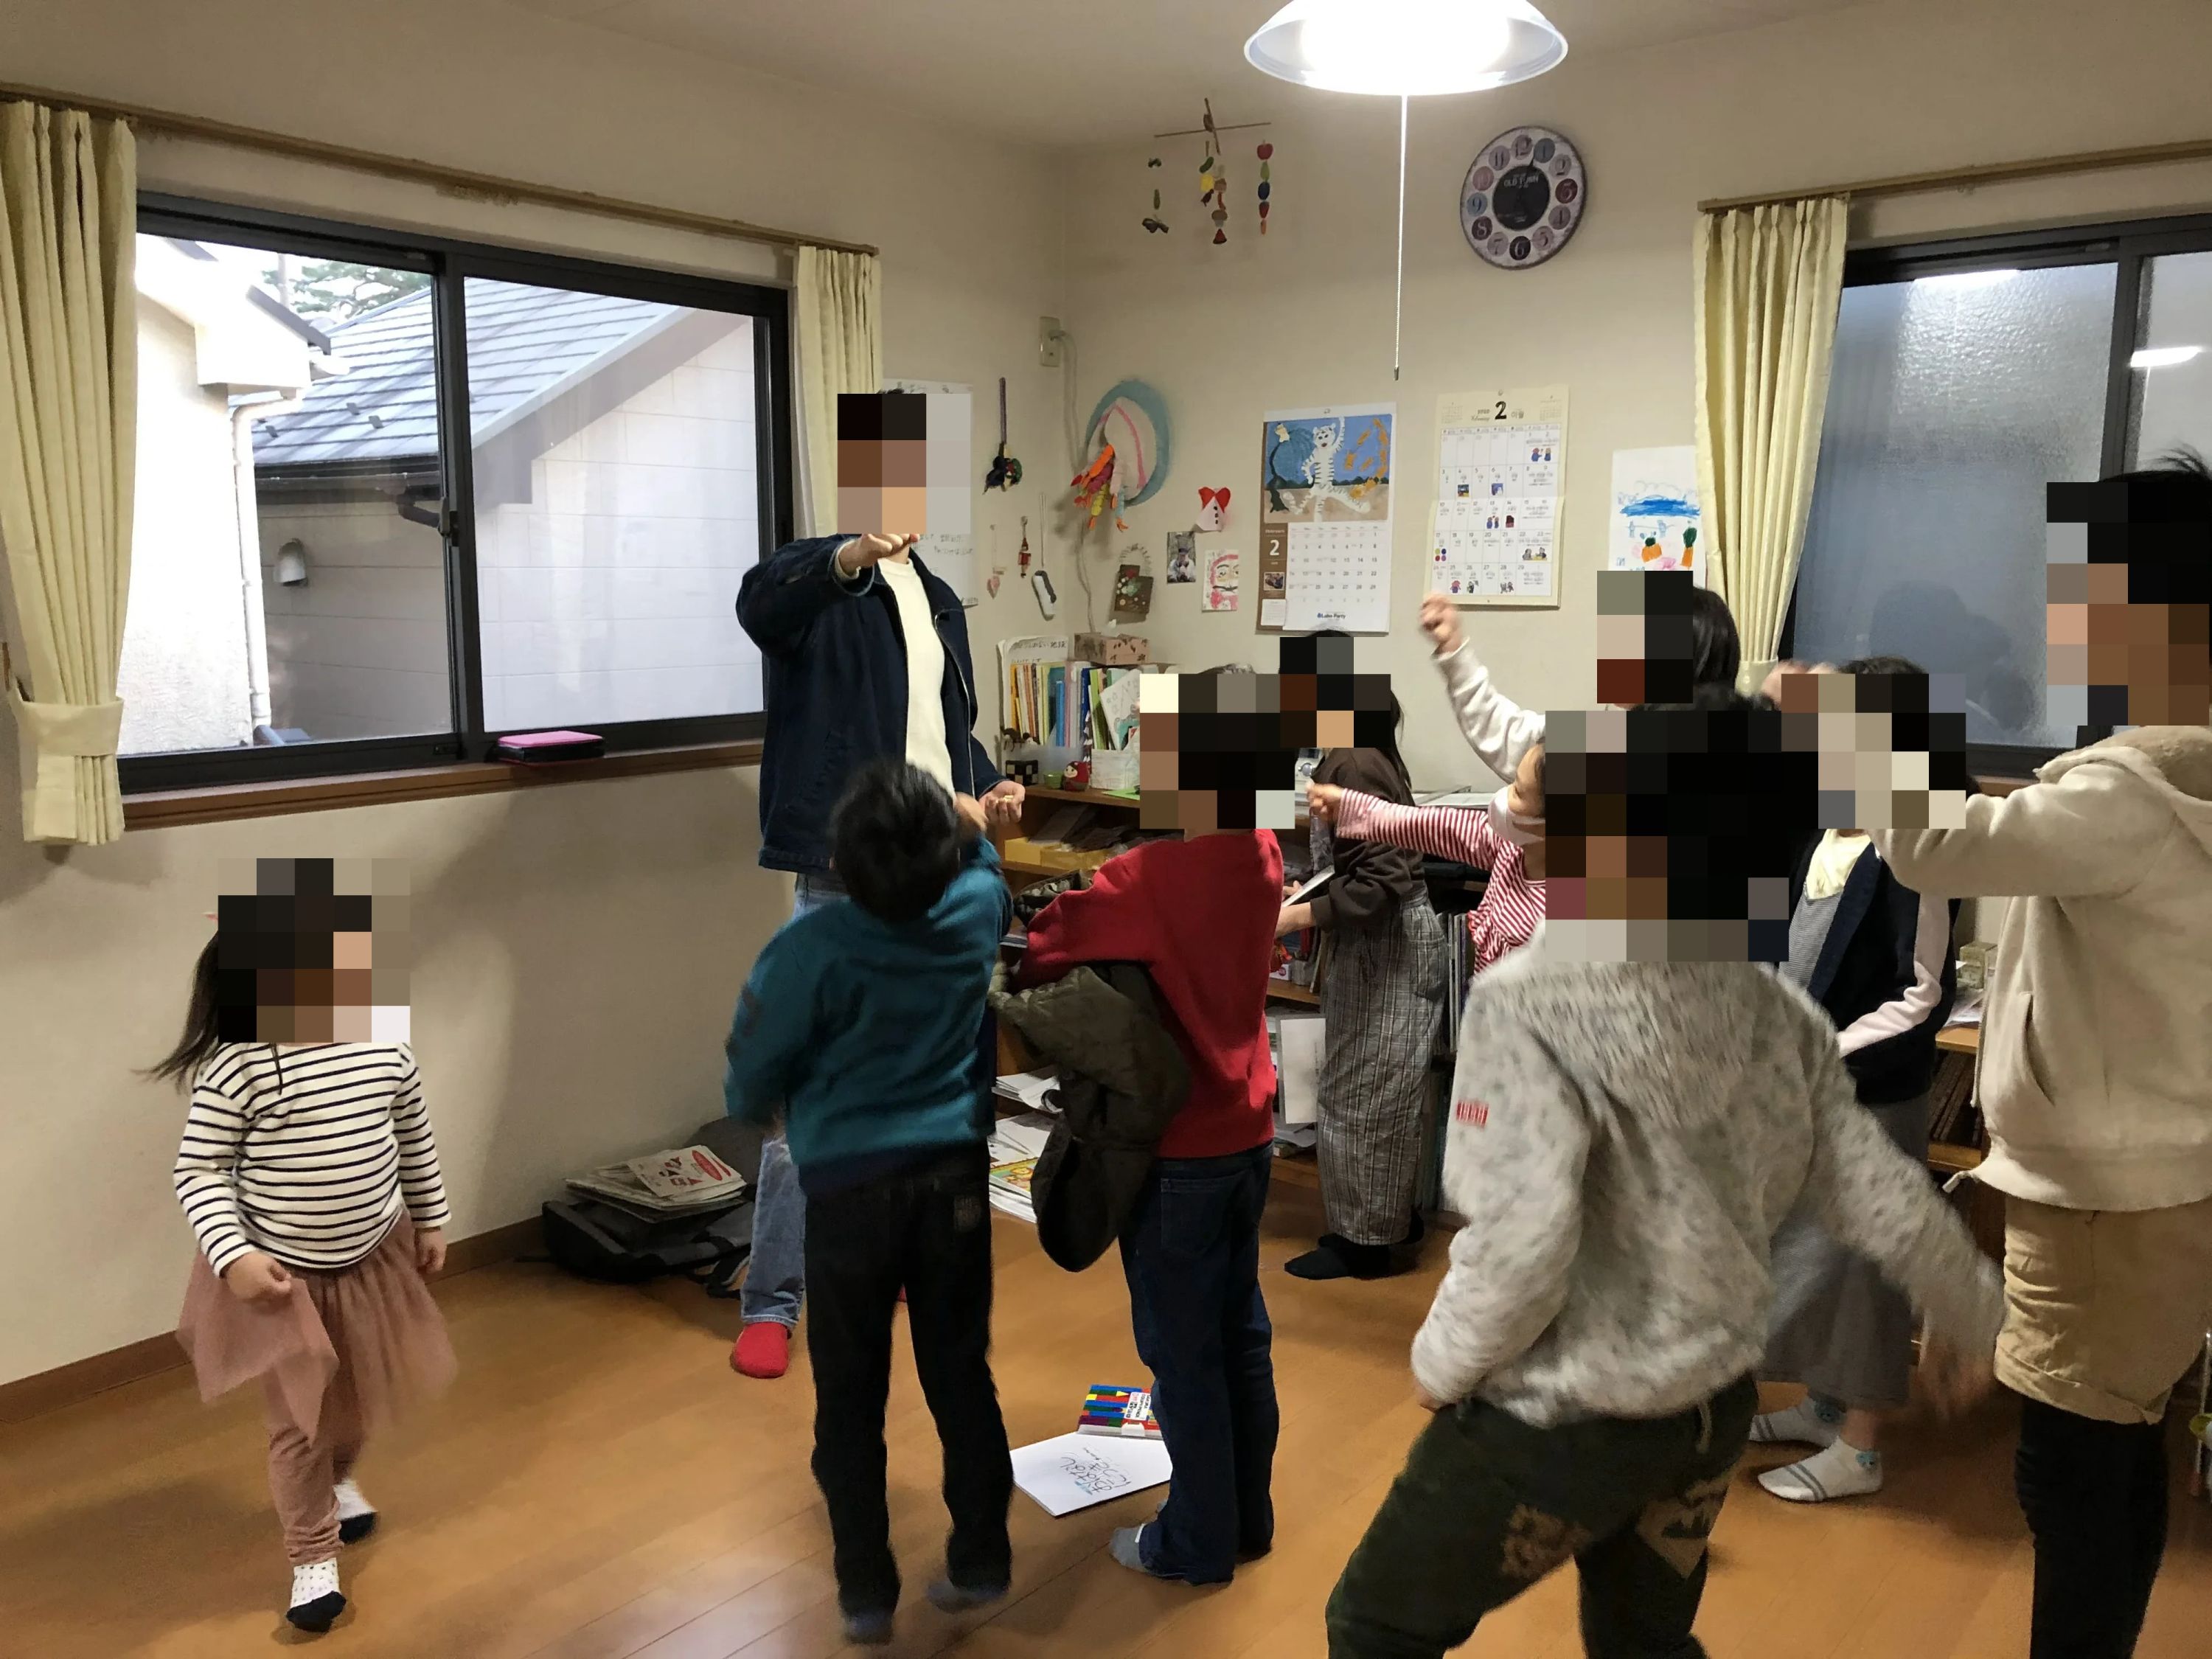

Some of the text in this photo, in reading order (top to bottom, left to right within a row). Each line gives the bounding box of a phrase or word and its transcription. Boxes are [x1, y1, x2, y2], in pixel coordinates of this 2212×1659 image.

[1495, 151, 1504, 167] 11
[1555, 159, 1566, 176] 2
[1472, 198, 1482, 213] 9
[1477, 221, 1487, 237] 8
[1493, 237, 1503, 254] 7
[1514, 240, 1525, 257] 6
[1495, 400, 1507, 420] 2
[1270, 539, 1279, 556] 2
